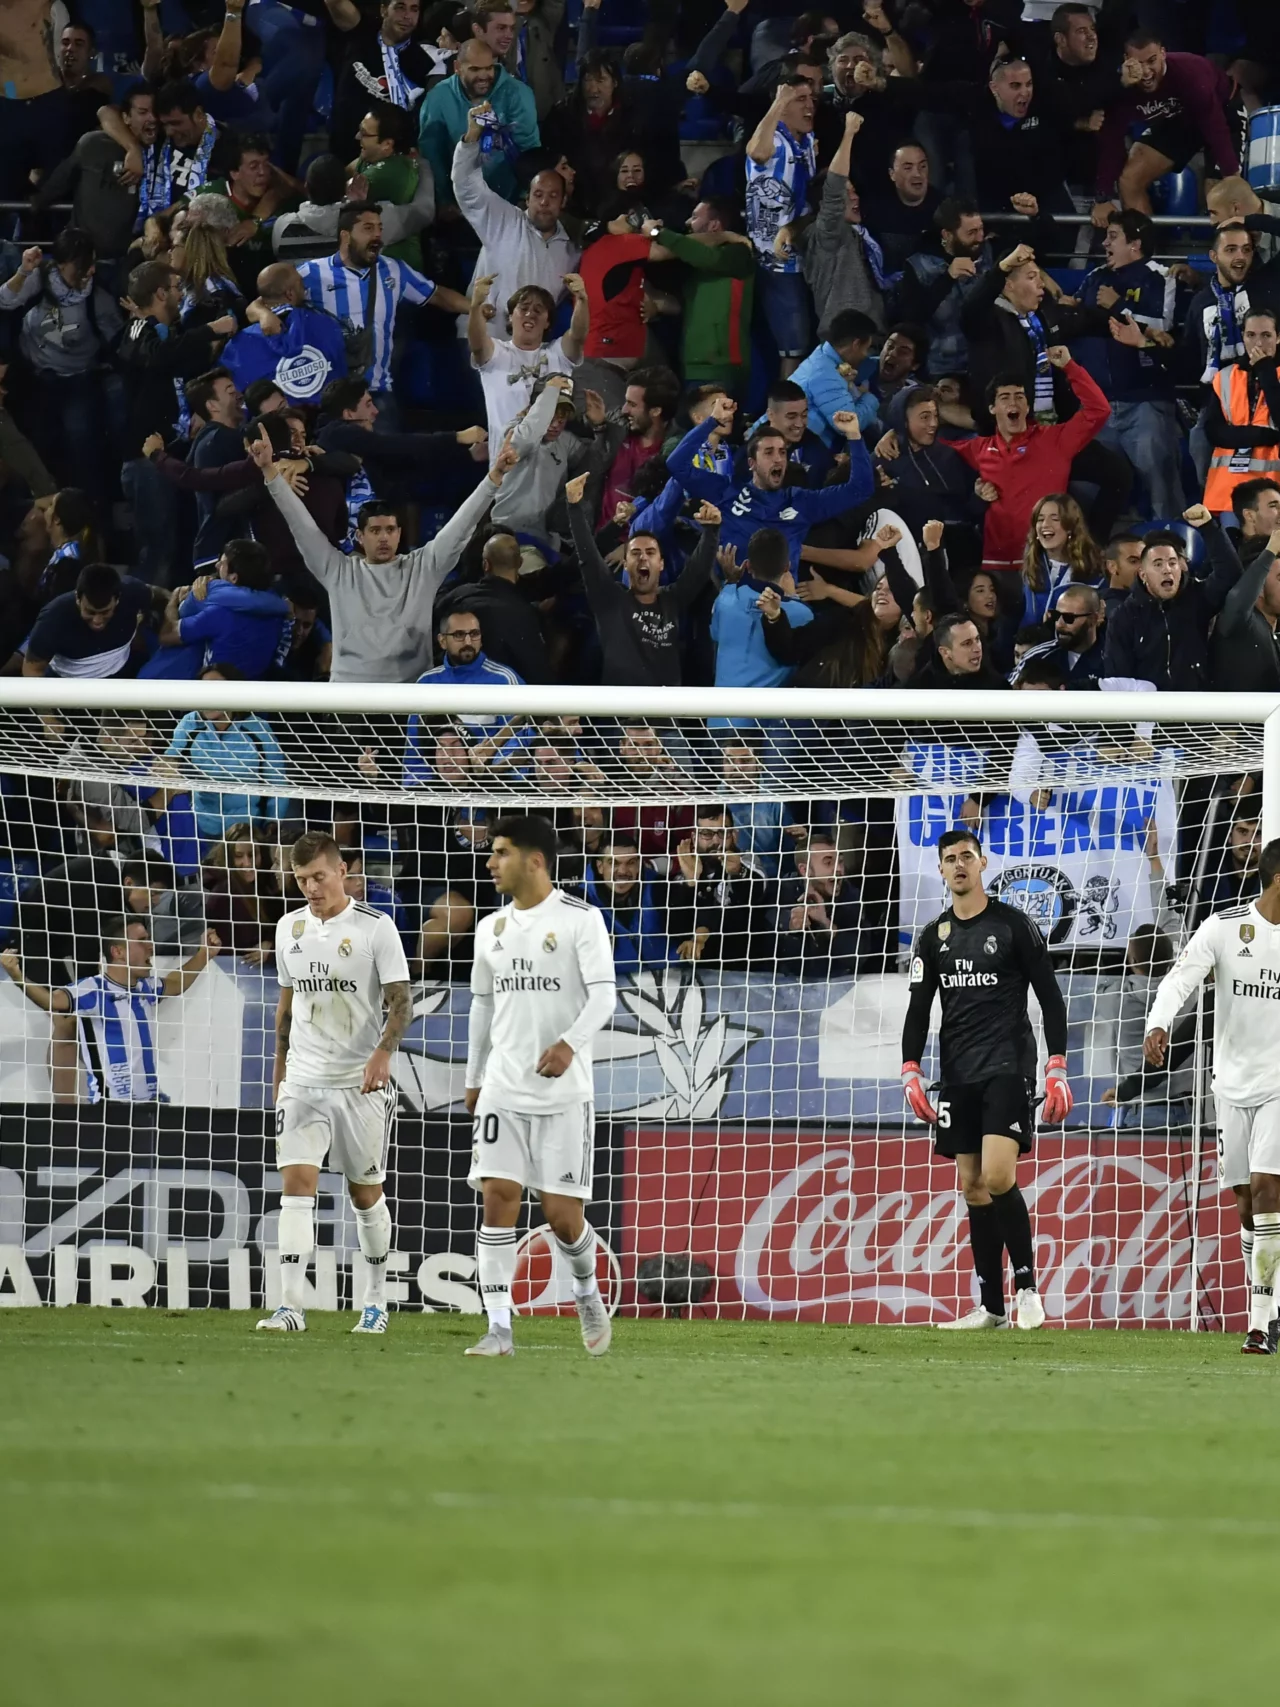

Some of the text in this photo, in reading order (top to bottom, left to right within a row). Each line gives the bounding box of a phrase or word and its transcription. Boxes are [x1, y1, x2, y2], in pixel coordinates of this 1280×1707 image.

[279, 360, 325, 382] GLORIOSO
[309, 962, 329, 975] Fly
[512, 958, 532, 972] Fly
[955, 959, 973, 972] Fly
[292, 976, 357, 992] Emirates
[495, 973, 561, 992] Emirates
[940, 971, 998, 988] Emirates
[276, 1108, 285, 1136] 8
[938, 1101, 951, 1128] 5
[471, 1113, 498, 1144] 20
